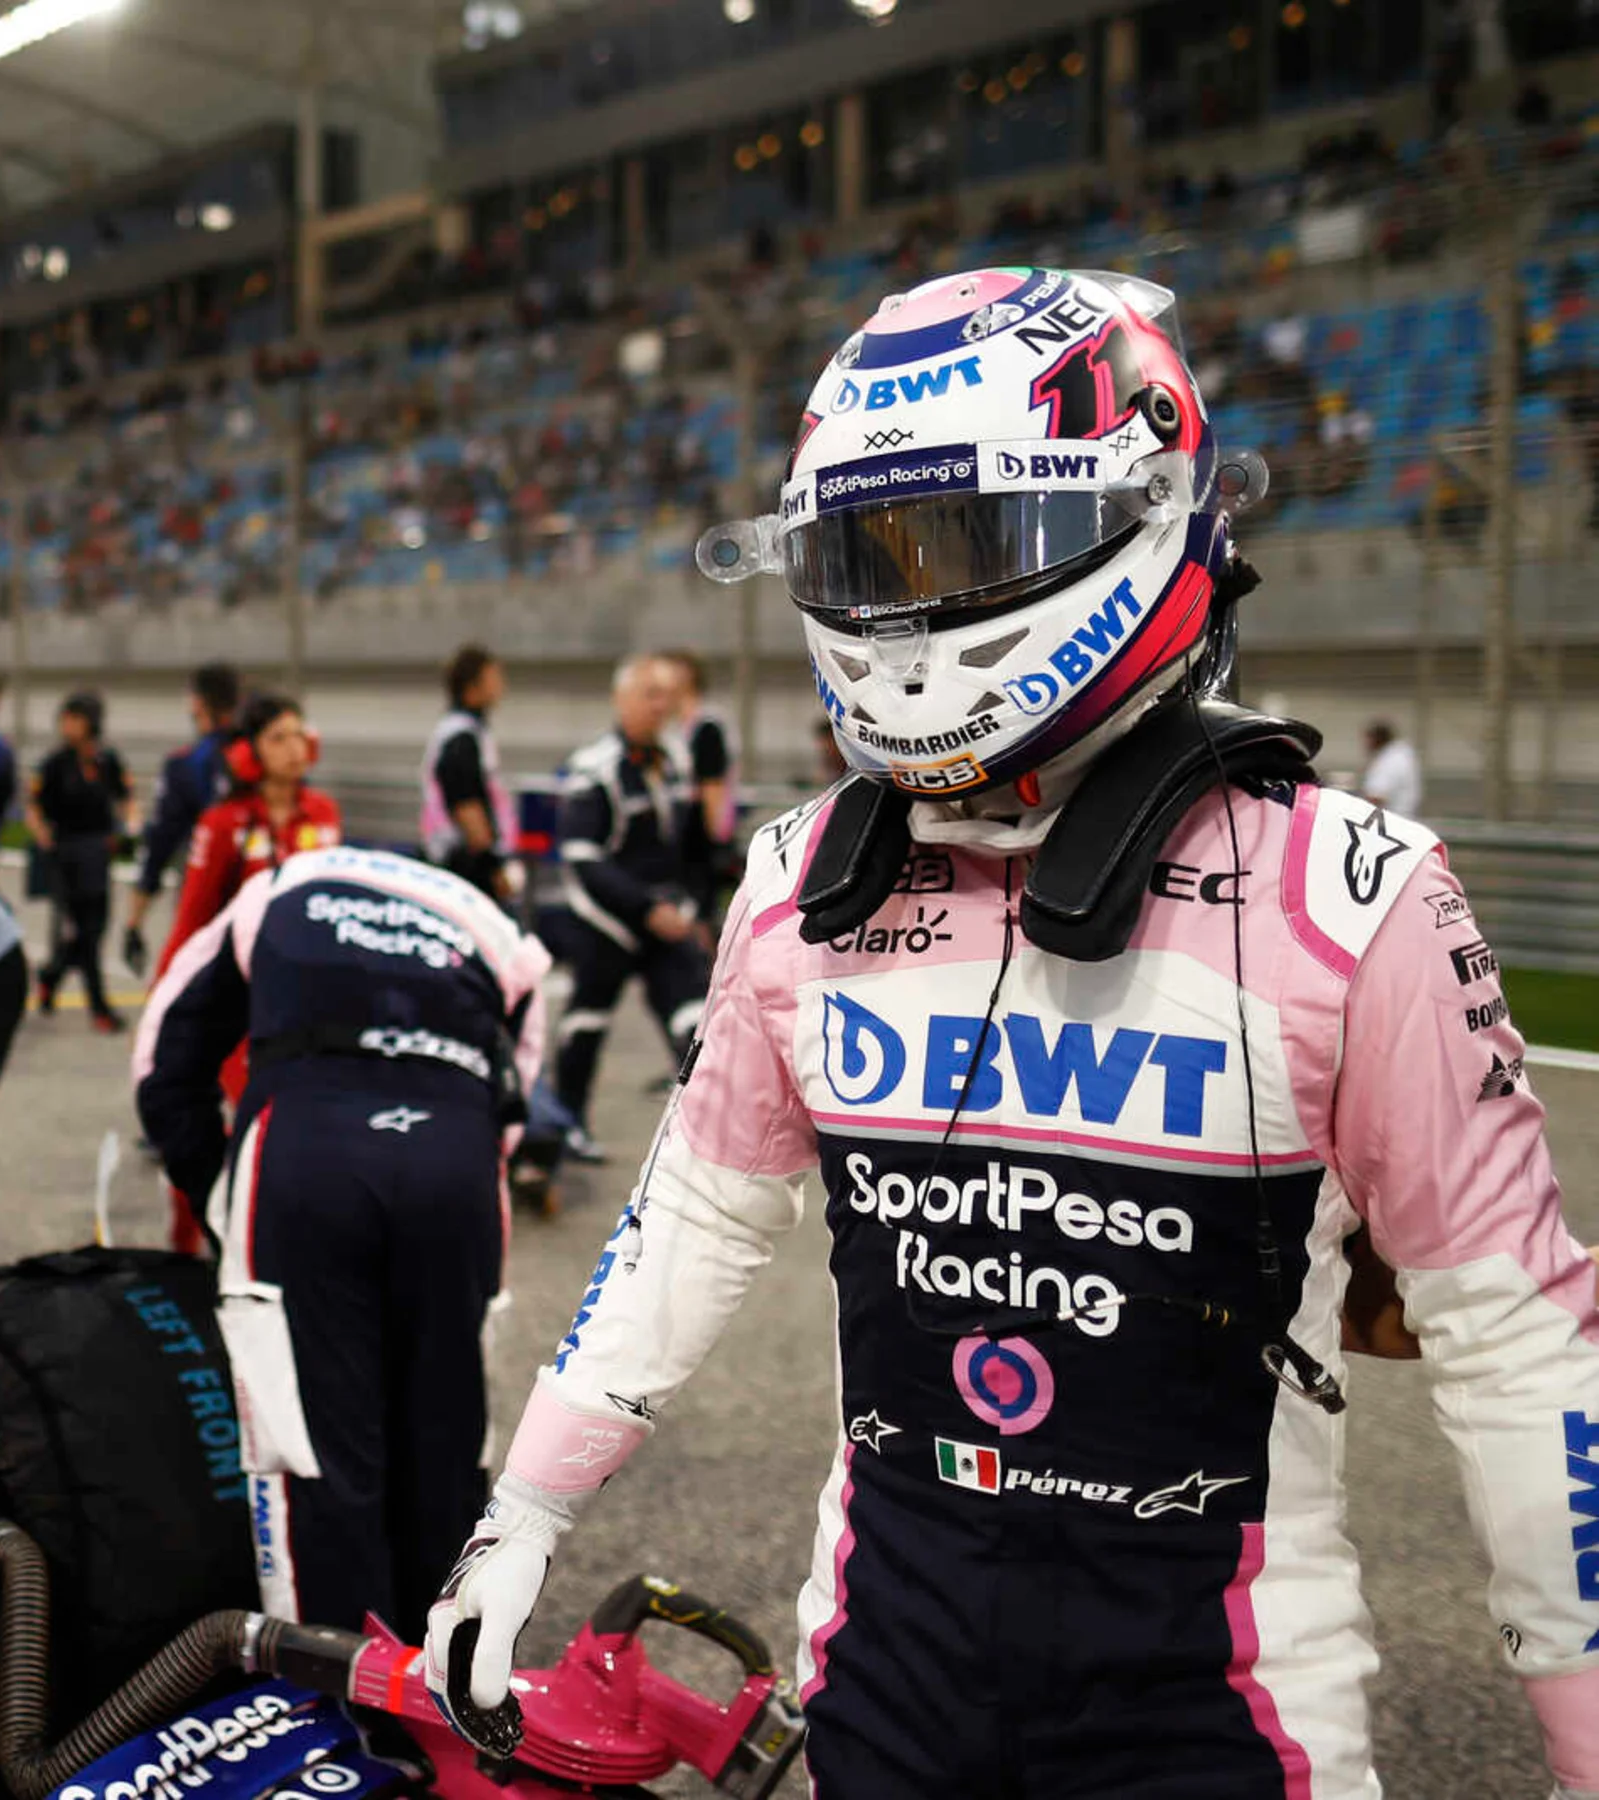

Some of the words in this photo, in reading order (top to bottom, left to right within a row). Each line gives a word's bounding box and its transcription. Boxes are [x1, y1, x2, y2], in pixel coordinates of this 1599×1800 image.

[864, 355, 983, 411] BWT
[820, 475, 888, 501] SportPesa
[890, 465, 950, 482] Racing
[1031, 455, 1099, 479] BWT
[1048, 576, 1142, 686] BWT
[857, 712, 1001, 757] BOMBARDIER
[899, 759, 978, 789] JCB
[1148, 861, 1252, 905] EC
[922, 1012, 1227, 1138] BWT
[845, 1151, 1194, 1254] SportPesa
[896, 1228, 1120, 1338] Racing
[124, 1286, 205, 1354] LEFT
[1004, 1468, 1134, 1503] Pérez
